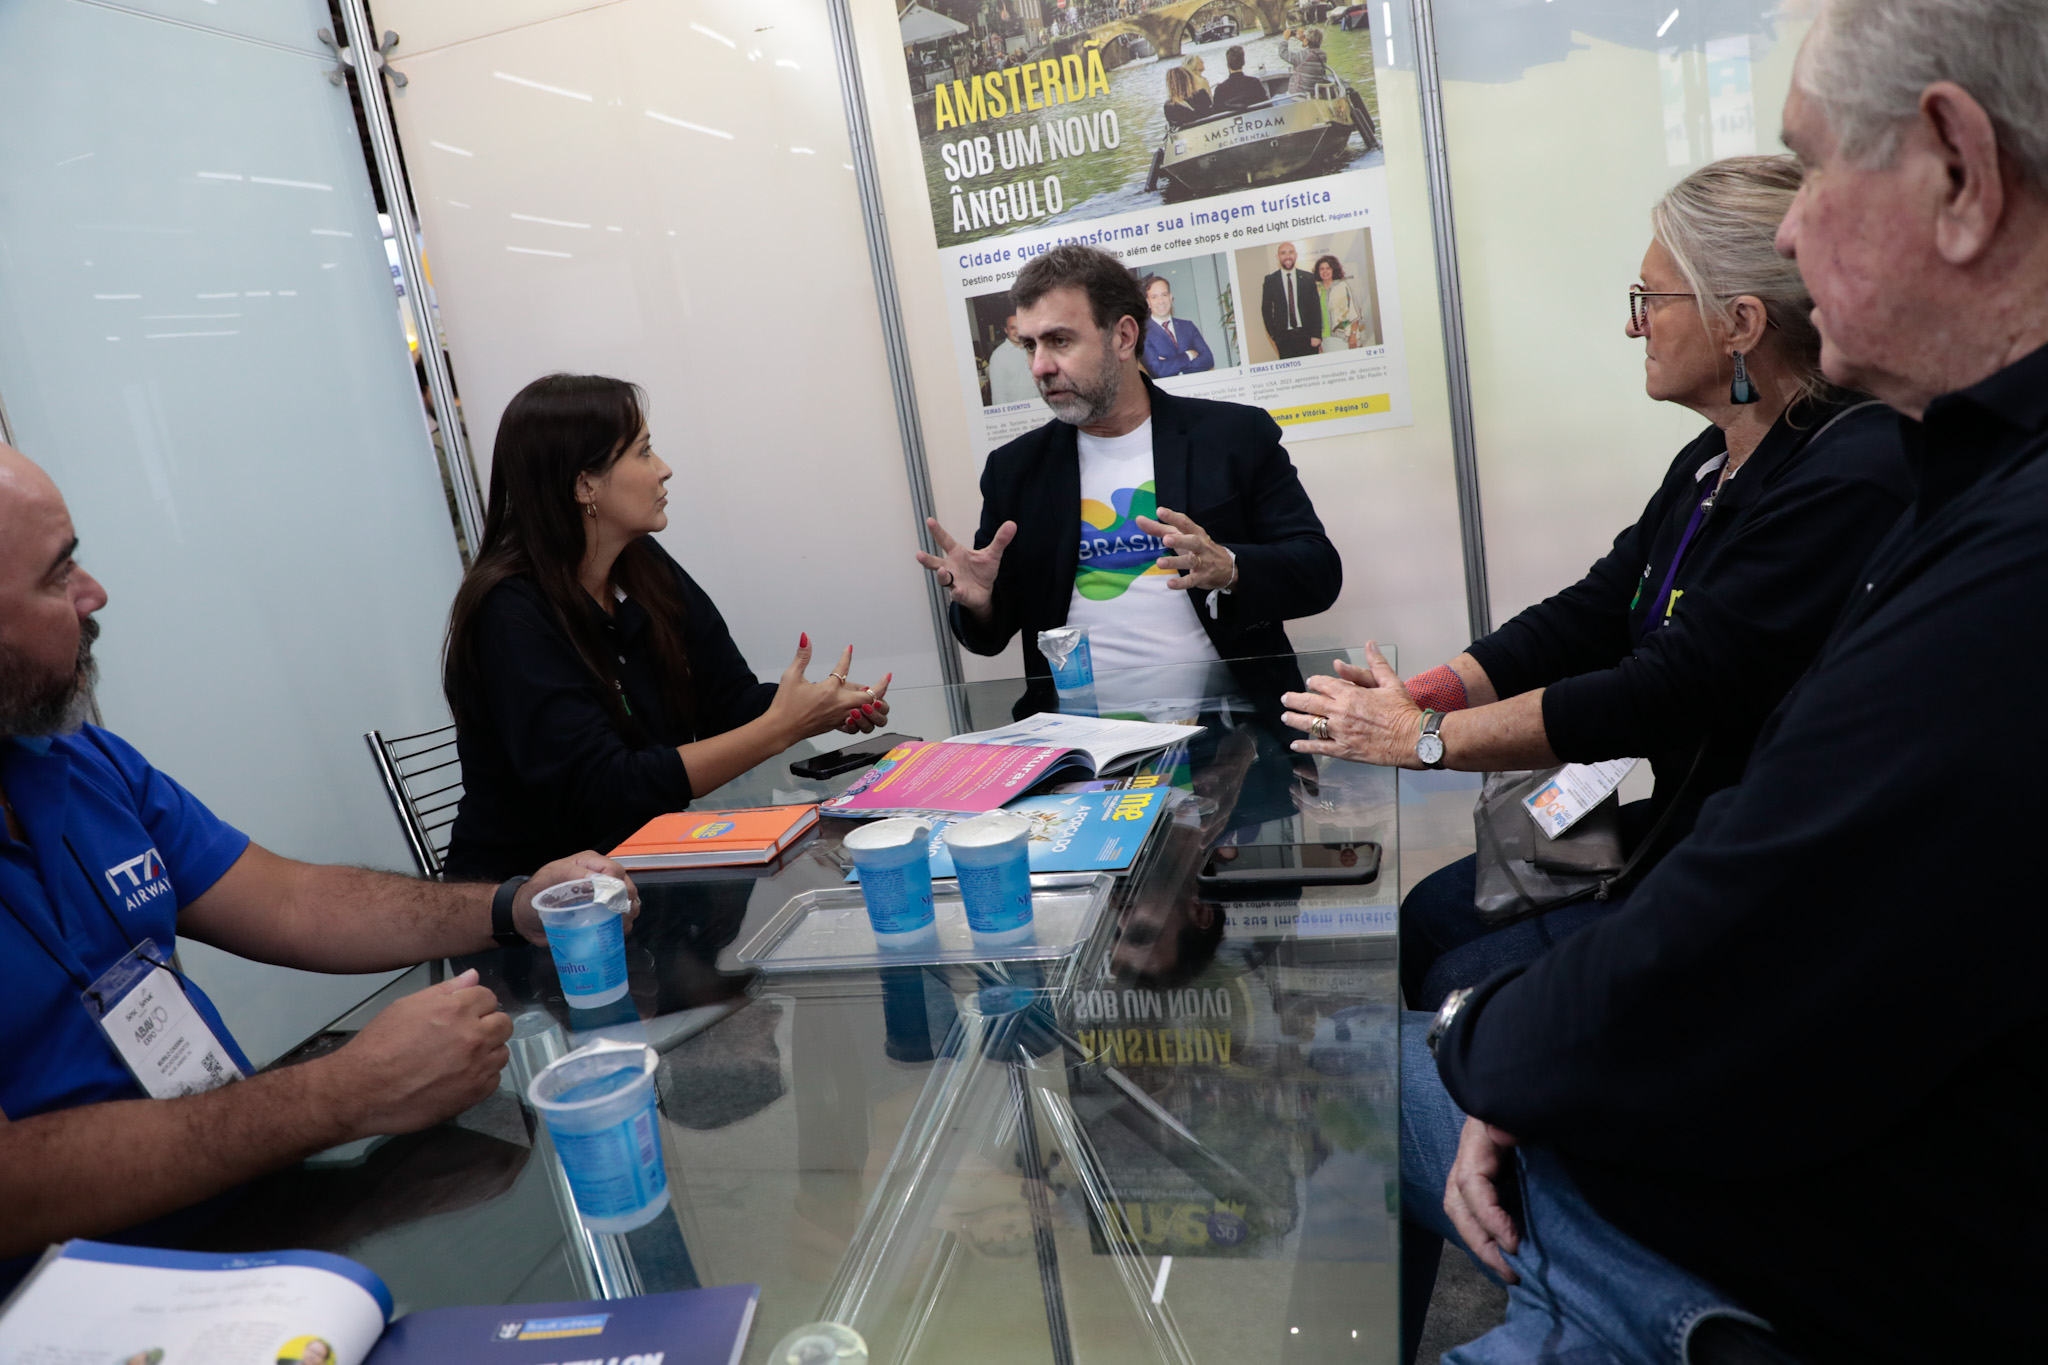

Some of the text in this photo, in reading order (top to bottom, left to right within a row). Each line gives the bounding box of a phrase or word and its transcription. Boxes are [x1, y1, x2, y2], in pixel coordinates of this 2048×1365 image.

[935, 38, 1111, 131] AMSTERDÃ
[941, 109, 1121, 182] SOB UM NOVO
[1240, 131, 1270, 143] RENTAL
[950, 175, 1064, 233] ÂNGULO
[959, 249, 1011, 269] Cidade
[1017, 240, 1051, 261] quer
[1157, 217, 1184, 232] sua
[1190, 204, 1255, 224] imagem
[1261, 190, 1331, 213] turística
[962, 272, 993, 287] Destino
[995, 269, 1020, 282] possu
[1126, 245, 1148, 257] além
[1151, 243, 1161, 252] de
[1164, 238, 1192, 250] coffee
[1195, 233, 1221, 245] shops
[1223, 231, 1230, 239] e
[1232, 229, 1244, 238] do
[1246, 225, 1264, 235] Red
[1266, 220, 1289, 232] Light
[1291, 214, 1327, 227] District.
[1275, 361, 1302, 370] EVENTOS
[1007, 403, 1031, 411] EVENTOS
[1272, 413, 1293, 421] onhas
[1302, 409, 1328, 417] Vitória.
[1334, 404, 1359, 413] Página
[1078, 534, 1166, 561] BRASIL
[1052, 838, 1072, 852] DO
[105, 847, 166, 896] ITA
[125, 876, 171, 911] AIRWAY
[143, 1030, 157, 1047] EXPO
